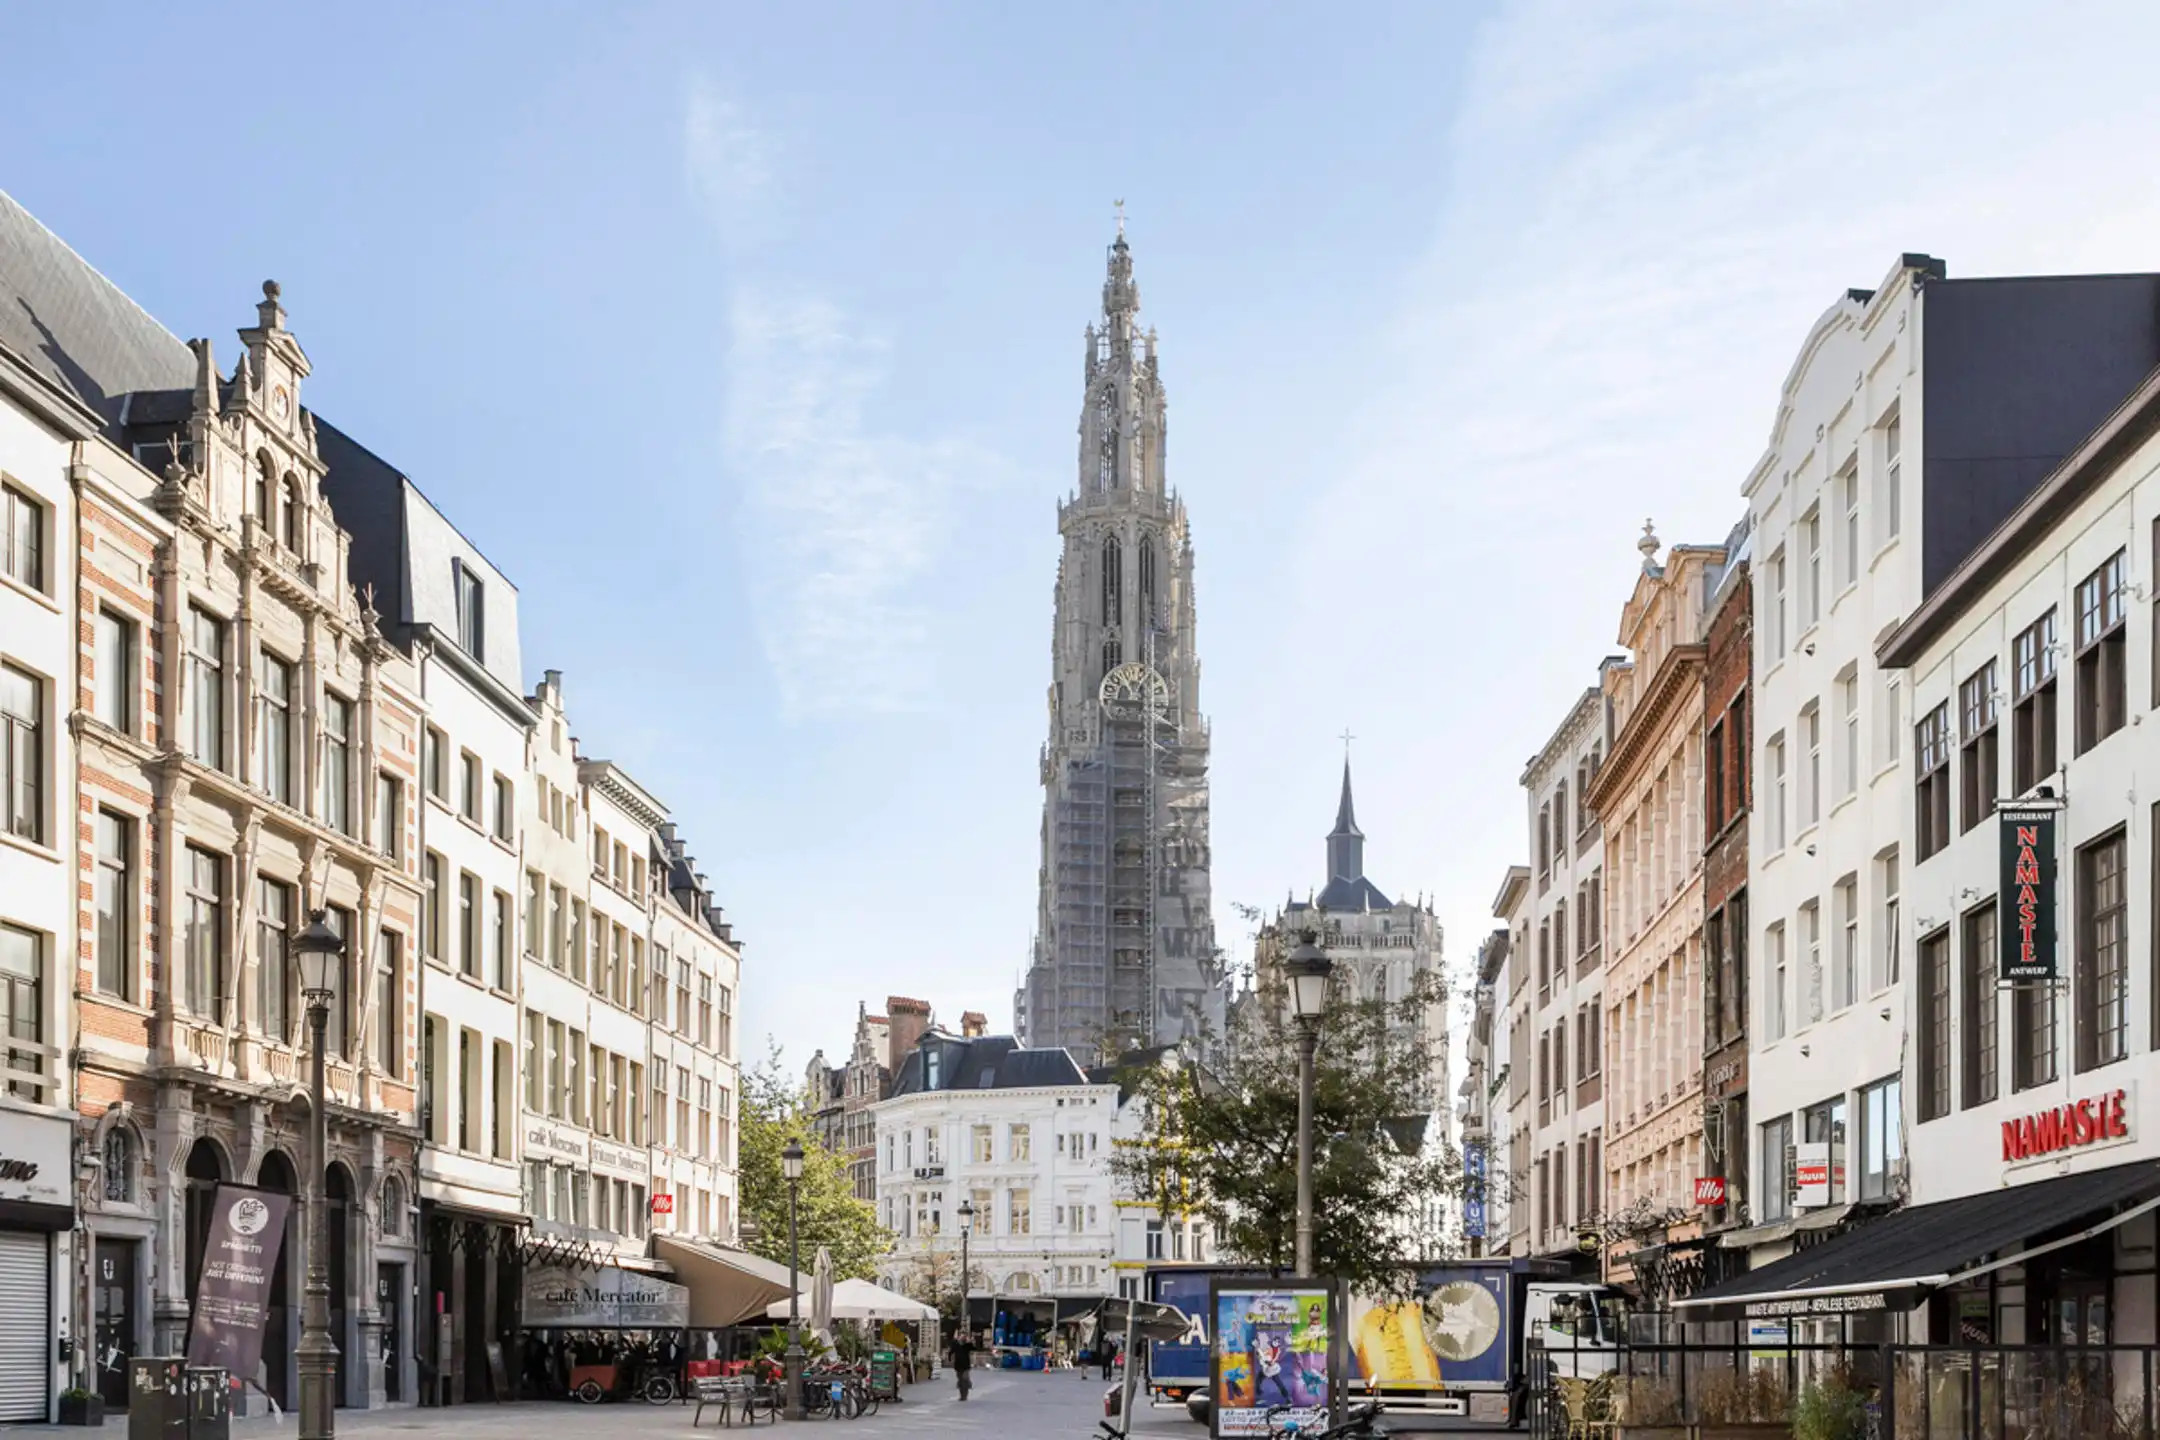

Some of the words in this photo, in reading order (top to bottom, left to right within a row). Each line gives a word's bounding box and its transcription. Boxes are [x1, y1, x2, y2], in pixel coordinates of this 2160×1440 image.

[2002, 812, 2053, 821] RESTAURANT
[2014, 825, 2040, 962] NAMASTE
[2009, 966, 2048, 976] ANTWERP
[2001, 1088, 2128, 1162] NAMASTE
[1697, 1181, 1723, 1204] illy
[545, 1286, 578, 1303] café
[583, 1287, 660, 1304] Mercator
